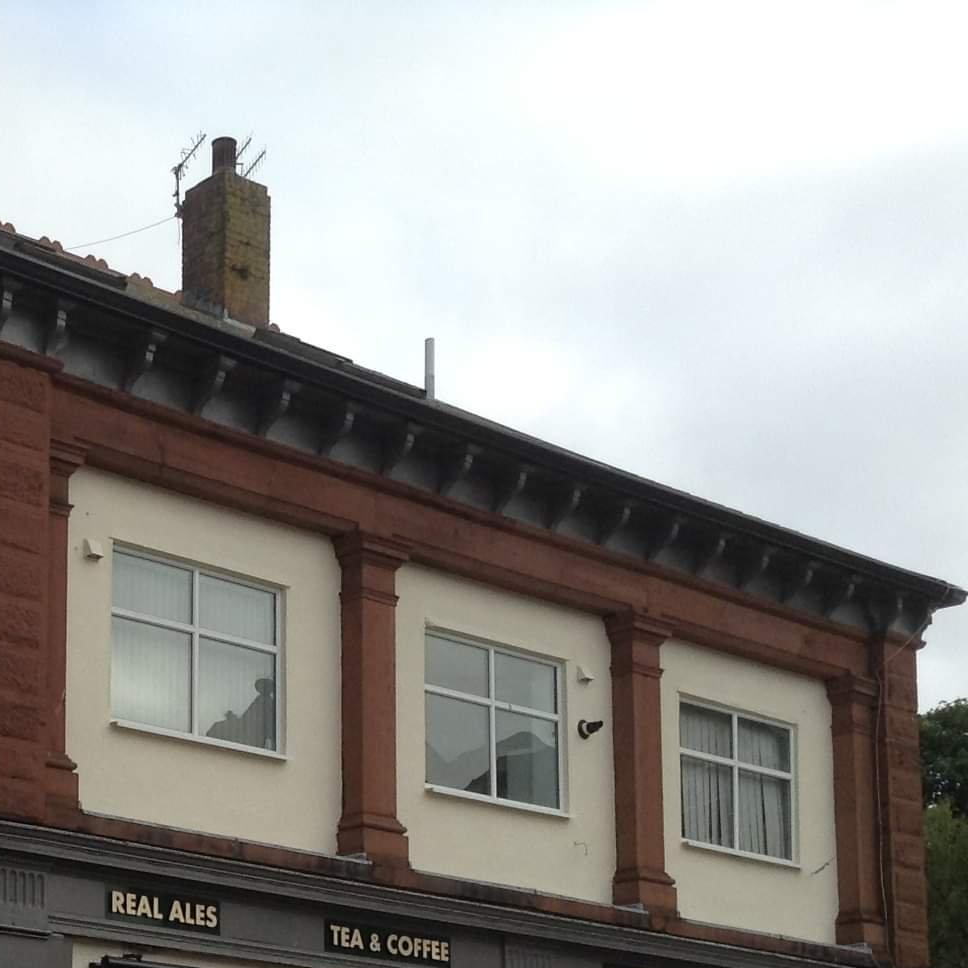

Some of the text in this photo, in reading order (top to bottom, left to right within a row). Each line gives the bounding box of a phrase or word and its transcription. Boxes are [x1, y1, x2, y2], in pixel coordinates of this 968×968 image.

[111, 889, 218, 928] REAL ALES
[330, 924, 450, 962] TEA & COFFEE
